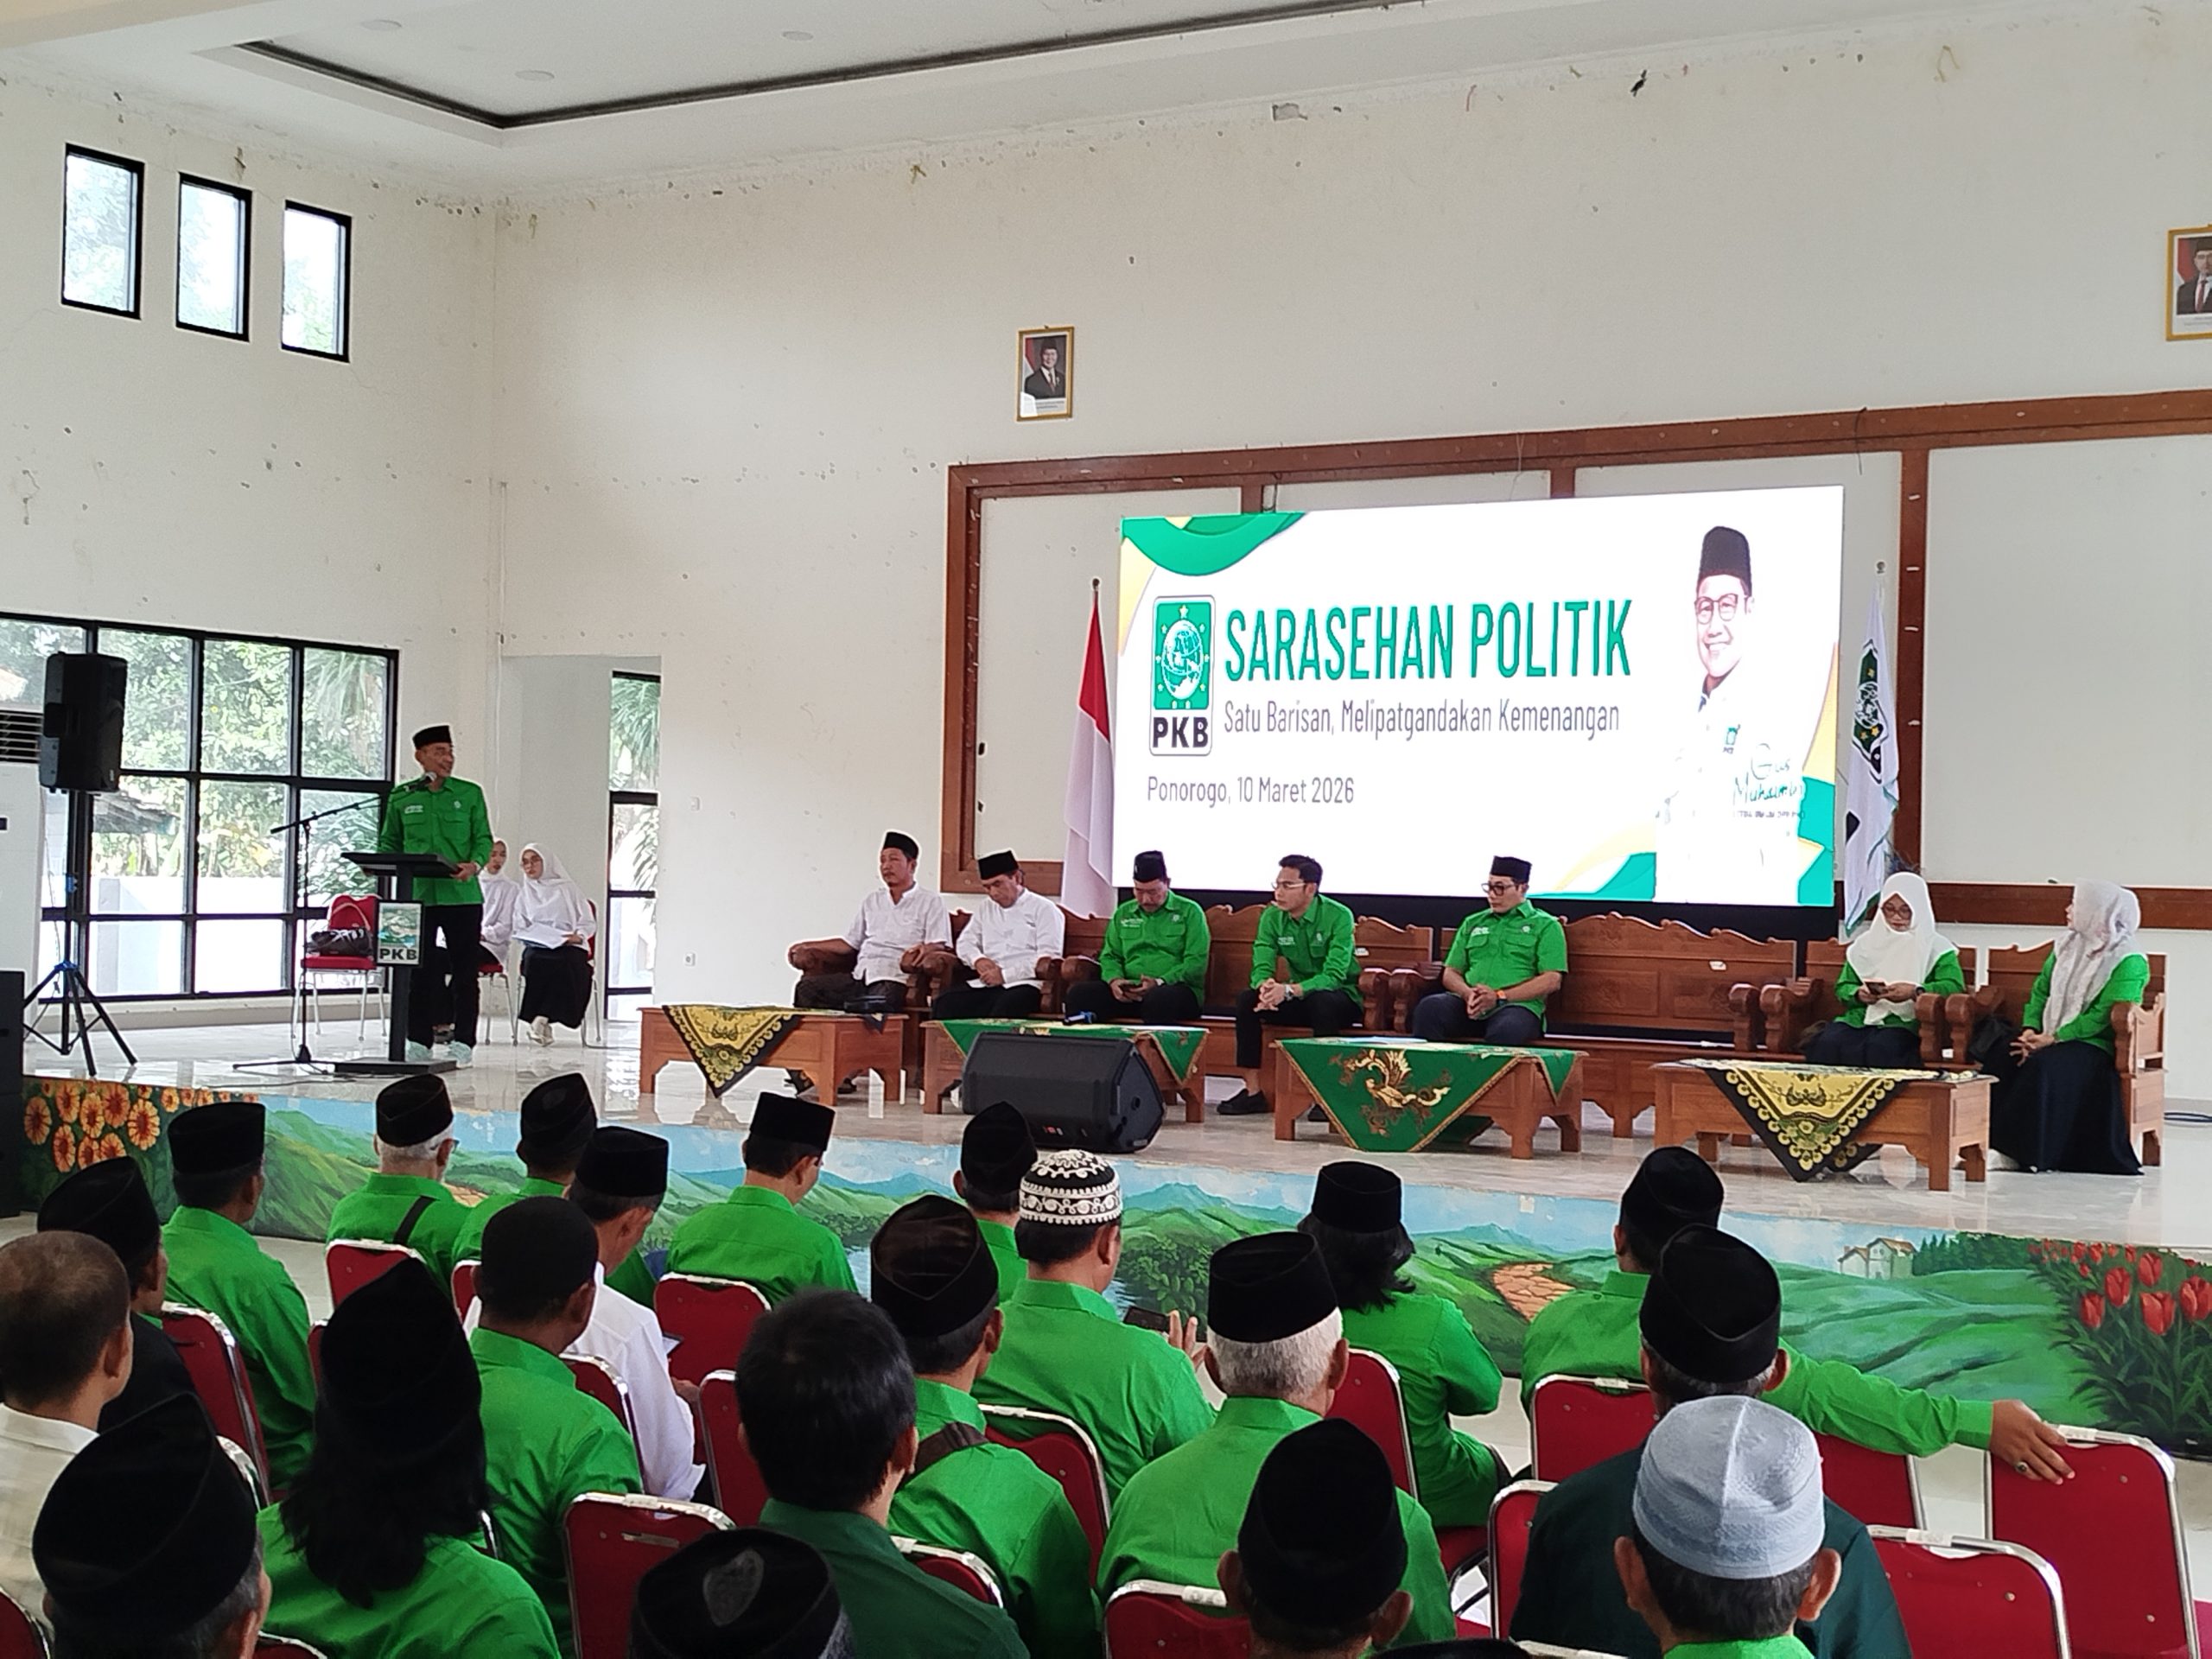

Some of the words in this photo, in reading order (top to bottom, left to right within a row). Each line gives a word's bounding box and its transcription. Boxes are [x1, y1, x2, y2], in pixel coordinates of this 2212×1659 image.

[1224, 604, 1453, 681] SARASEHAN
[1471, 600, 1632, 677] POLITIK
[1153, 716, 1209, 748] PKB
[1224, 700, 1261, 733] Satu
[1268, 700, 1334, 735] Barisan,
[1341, 698, 1492, 741] Melipatgandakan
[1498, 698, 1619, 741] Kemenangan
[1147, 776, 1231, 809] Ponorogo,
[1236, 776, 1253, 803] 10
[1258, 777, 1307, 804] Maret
[1312, 777, 1355, 804] 2026
[379, 948, 417, 960] PKB
